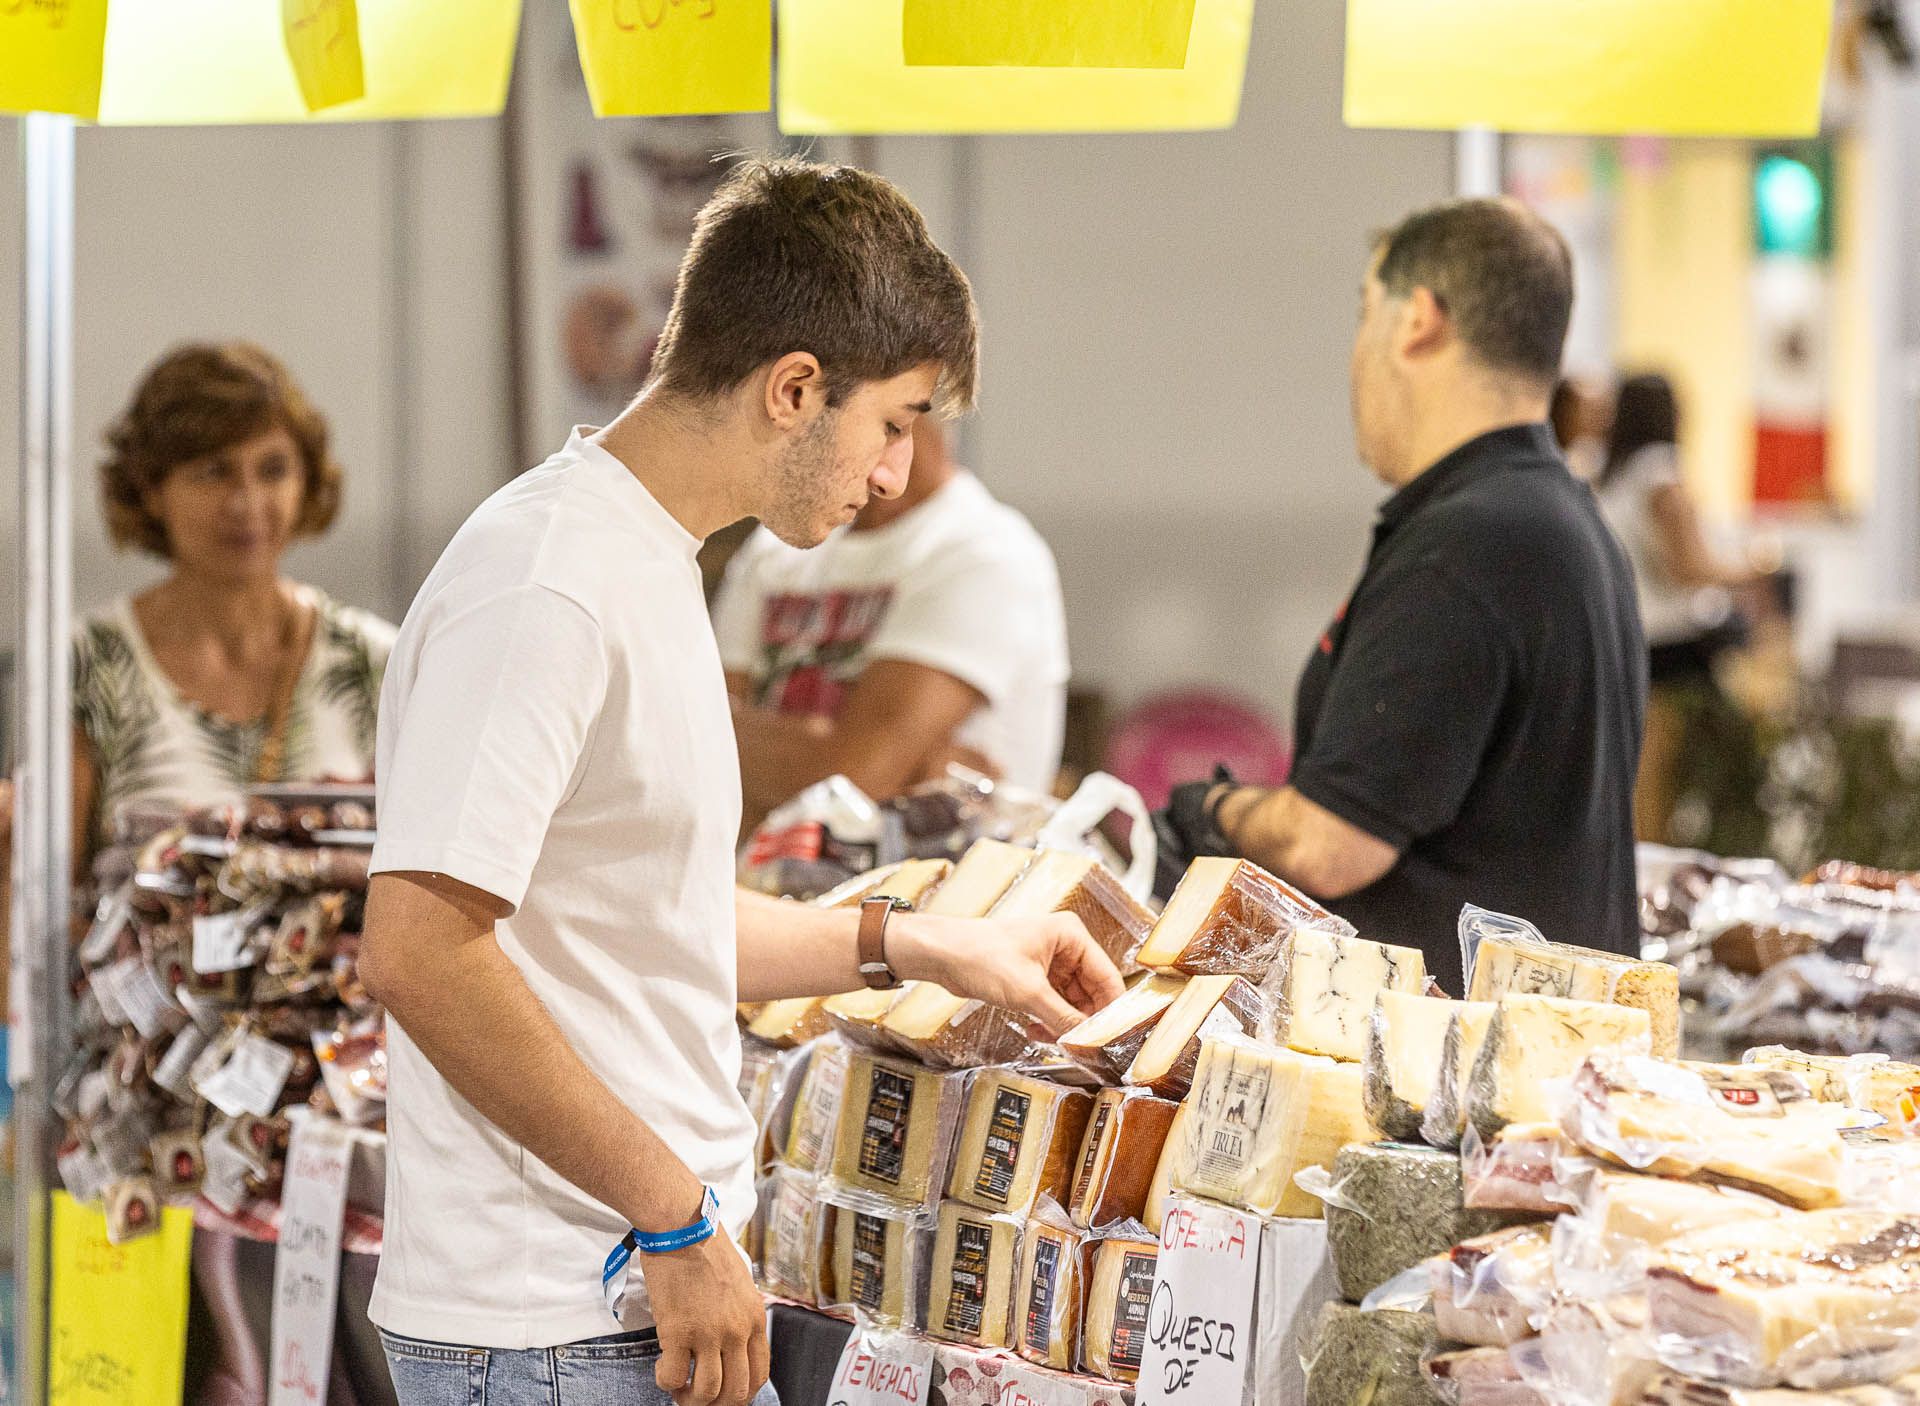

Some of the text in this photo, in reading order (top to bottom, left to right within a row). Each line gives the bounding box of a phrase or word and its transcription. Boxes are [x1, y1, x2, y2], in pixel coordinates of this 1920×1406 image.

[1212, 1130, 1242, 1157] TRUFA
[1164, 1208, 1245, 1260] OFEA
[1164, 1358, 1199, 1395] DE
